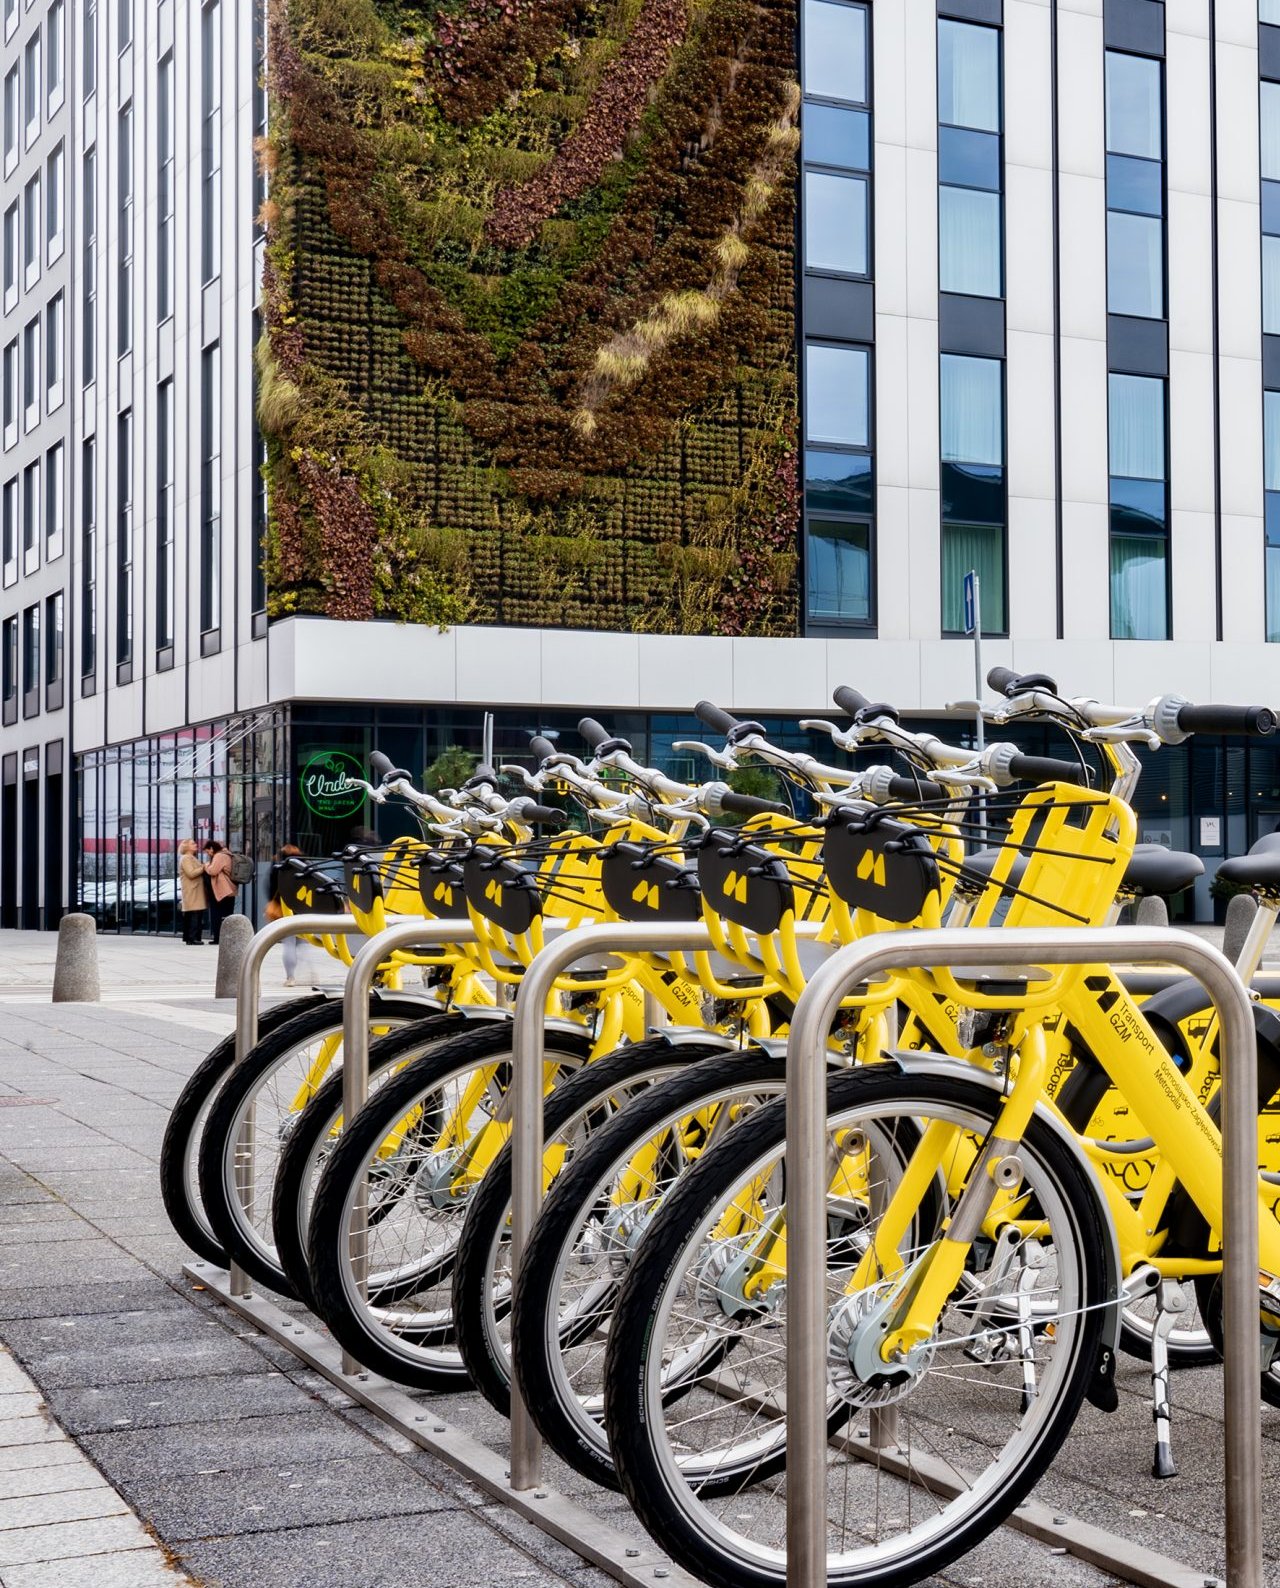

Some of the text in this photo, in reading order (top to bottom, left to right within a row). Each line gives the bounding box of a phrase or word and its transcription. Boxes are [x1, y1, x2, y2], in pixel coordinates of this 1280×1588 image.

[626, 986, 642, 1006] sport
[672, 986, 691, 1007] GZM
[681, 981, 698, 1005] Trans
[1110, 1013, 1132, 1043] GZM
[1120, 1000, 1154, 1055] Transport
[1154, 1069, 1181, 1110] Metropolia
[1197, 1071, 1216, 1105] 0391
[652, 1282, 665, 1311] DELTA
